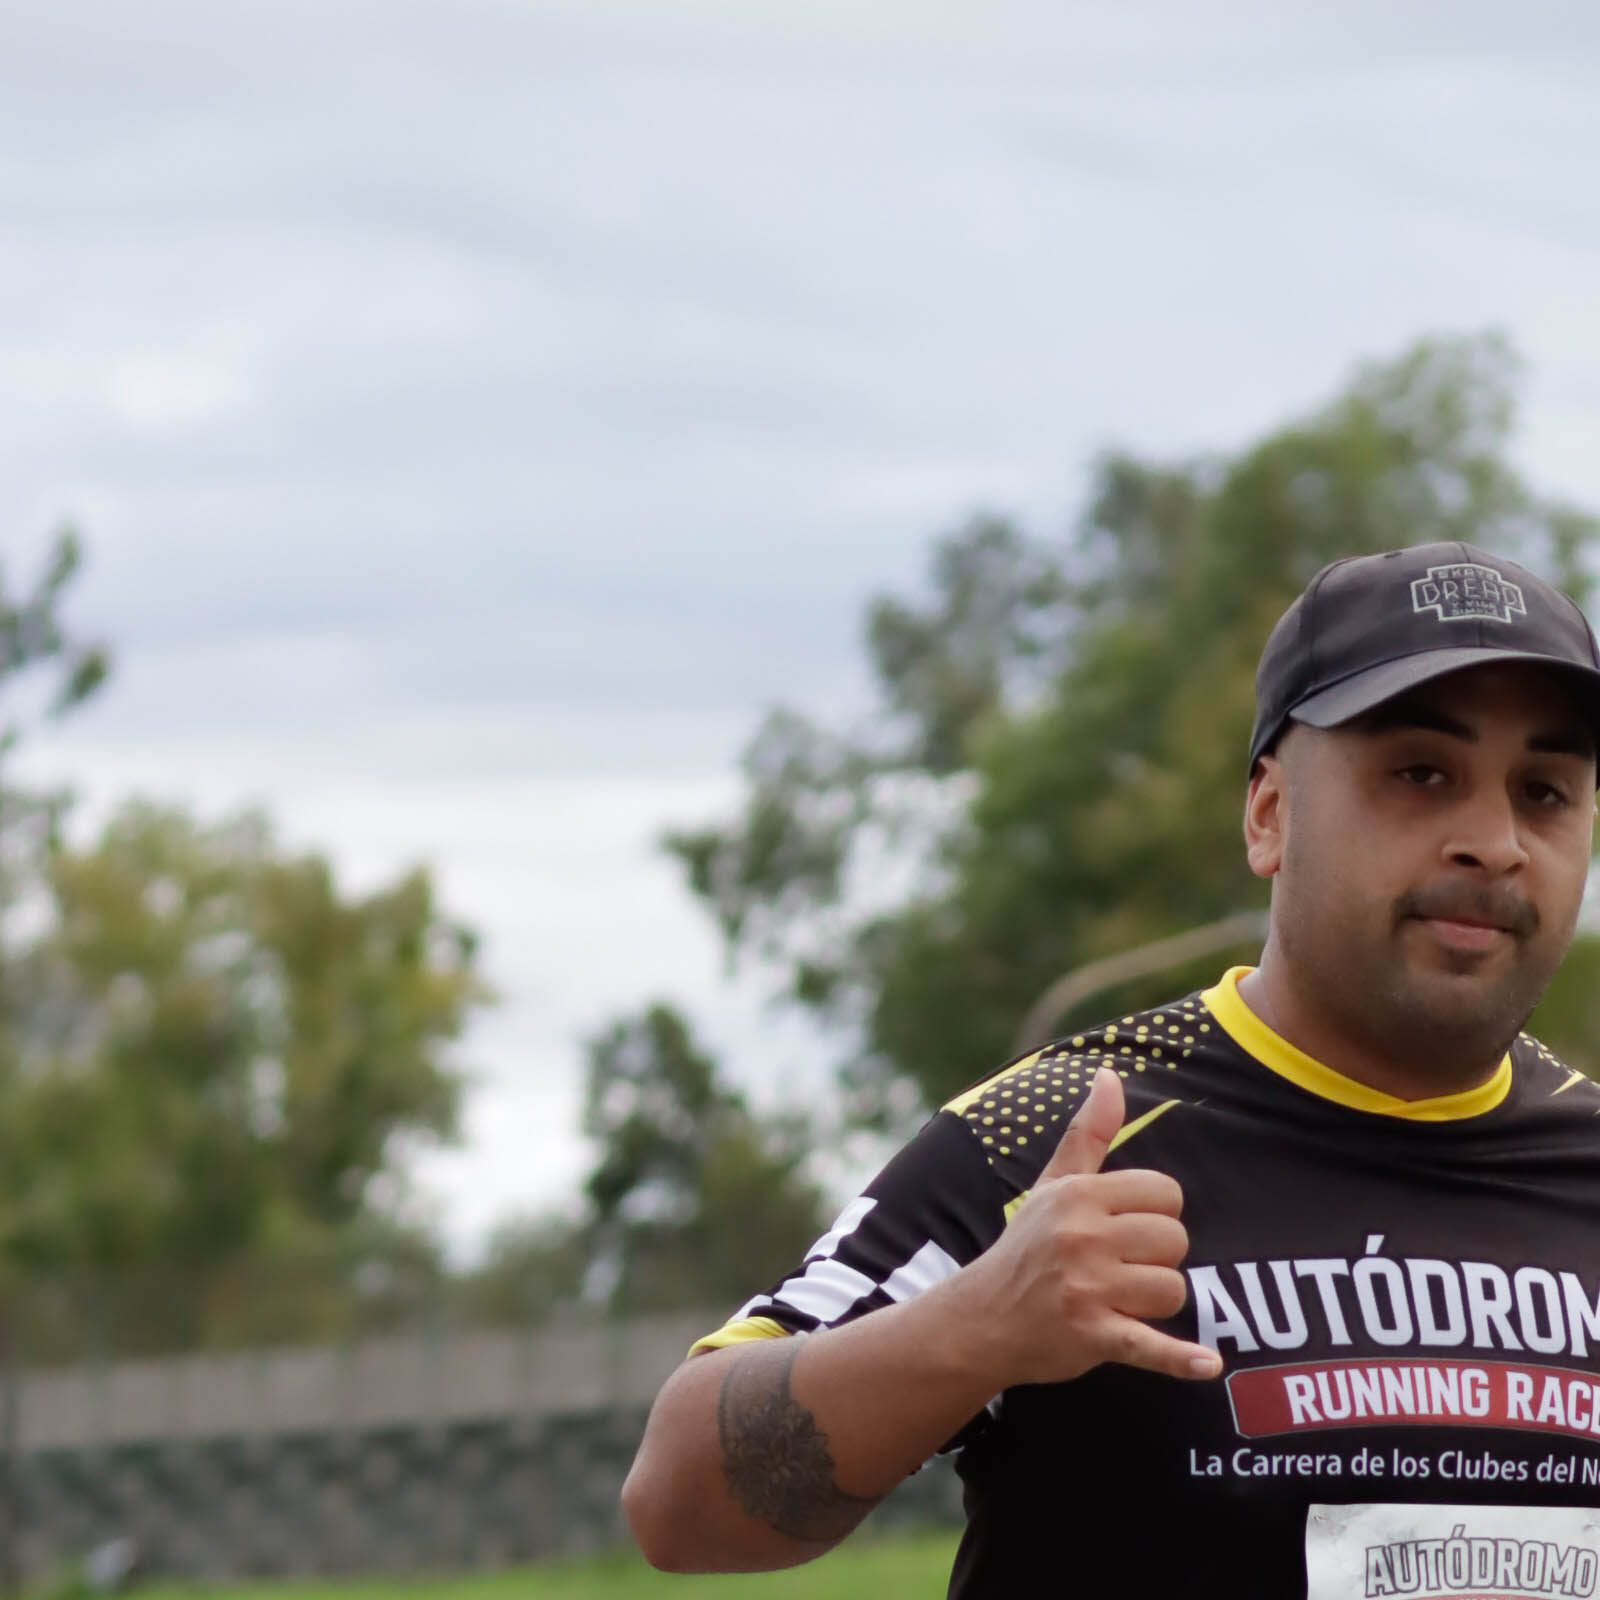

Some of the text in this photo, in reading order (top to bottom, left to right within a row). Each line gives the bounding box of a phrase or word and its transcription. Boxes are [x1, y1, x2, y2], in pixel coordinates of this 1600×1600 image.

[1422, 578, 1518, 605] DREAD
[1283, 1366, 1490, 1425] RUNNING
[1190, 1448, 1223, 1476] La
[1232, 1448, 1342, 1477] Carrera
[1351, 1447, 1385, 1476] de
[1393, 1448, 1430, 1478] los
[1438, 1450, 1529, 1482] Clubes
[1536, 1454, 1576, 1484] del
[1364, 1524, 1599, 1599] AUTÓDROMO
